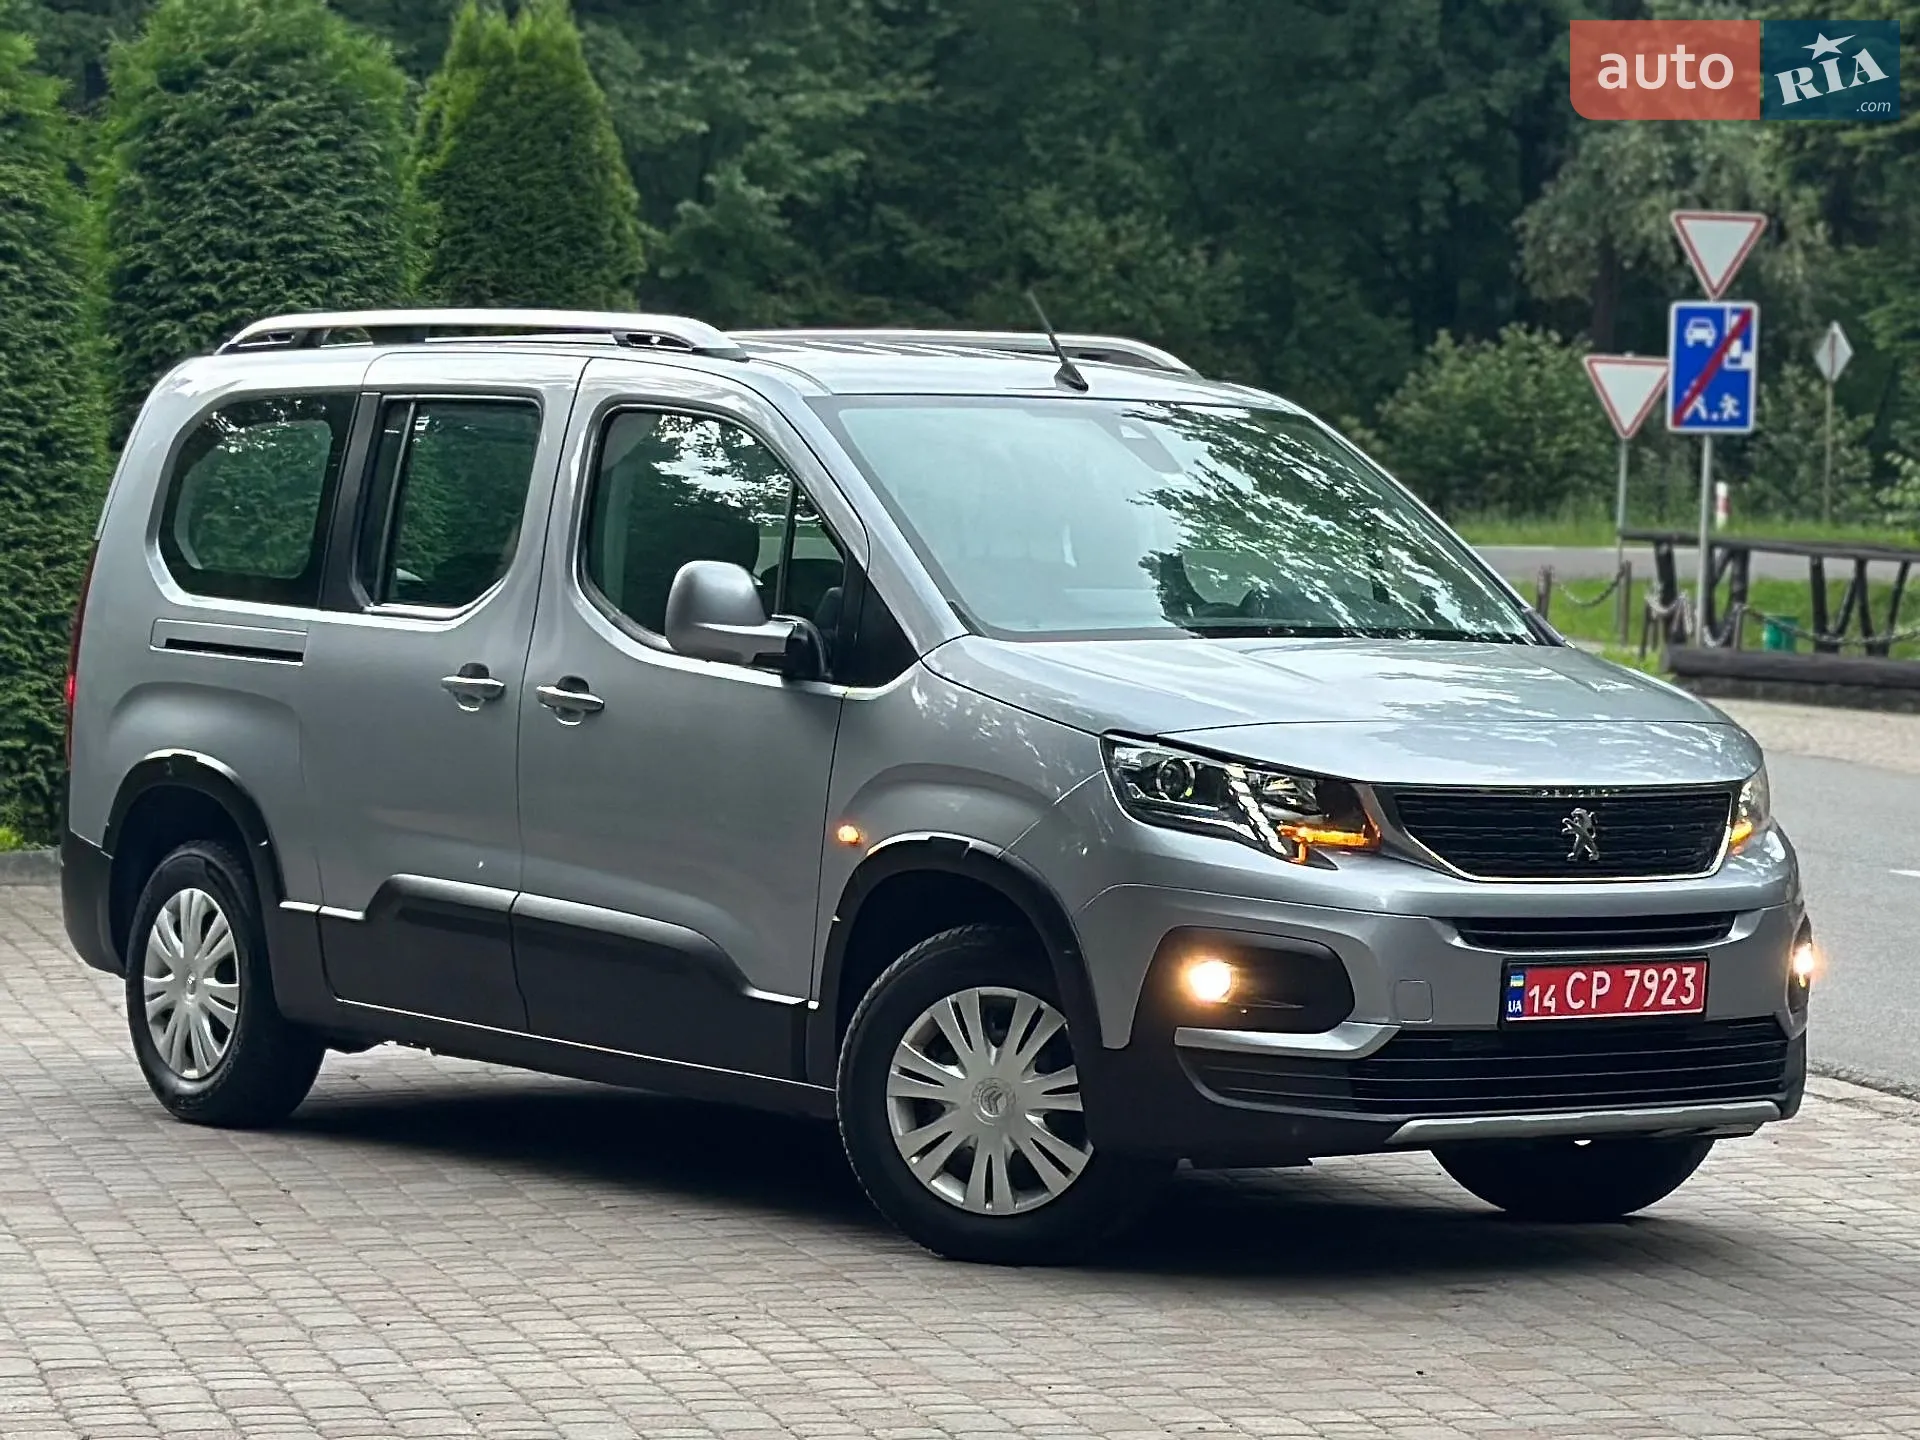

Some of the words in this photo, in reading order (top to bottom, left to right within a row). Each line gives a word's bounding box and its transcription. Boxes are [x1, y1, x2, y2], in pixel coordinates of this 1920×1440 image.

[1528, 984, 1556, 1014] 14
[1565, 971, 1611, 1010] CP
[1624, 966, 1696, 1008] 7923
[1508, 1000, 1522, 1013] UA
